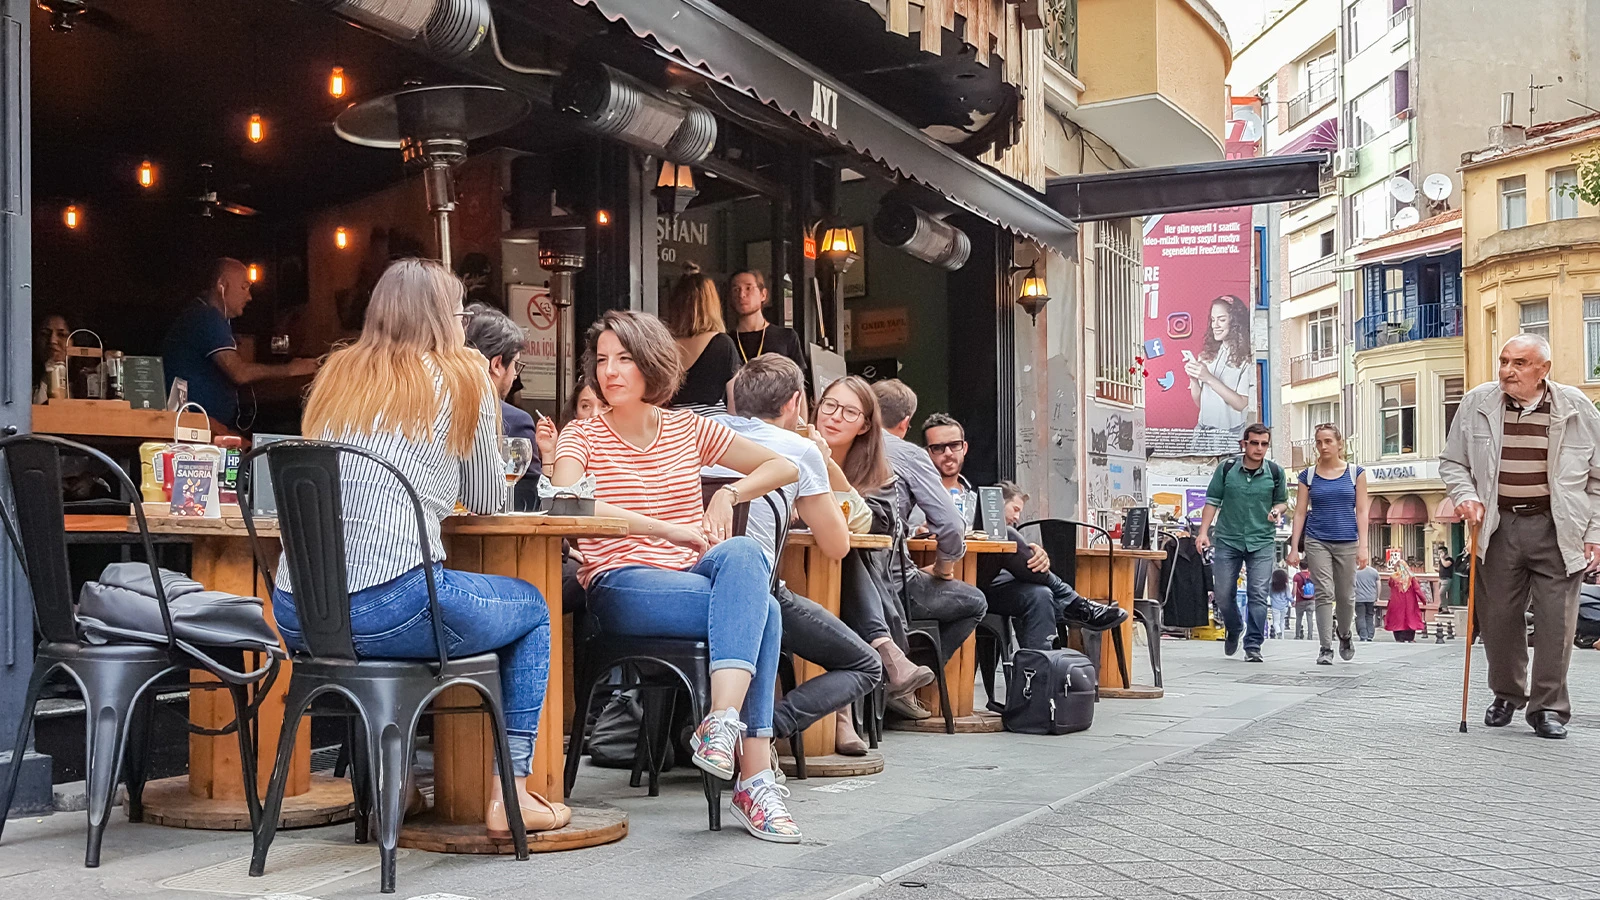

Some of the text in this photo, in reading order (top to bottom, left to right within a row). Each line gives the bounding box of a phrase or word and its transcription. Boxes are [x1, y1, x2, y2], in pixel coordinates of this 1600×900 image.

[811, 80, 838, 130] AYI
[1164, 221, 1240, 235] Her gün geçerli 1 saatlik
[1143, 233, 1240, 246] ideo-müzik veya sosyal medya
[661, 247, 677, 262] 60
[1161, 245, 1198, 257] seçenekleri
[227, 456, 240, 466] HP
[177, 469, 212, 479] SANGRIA
